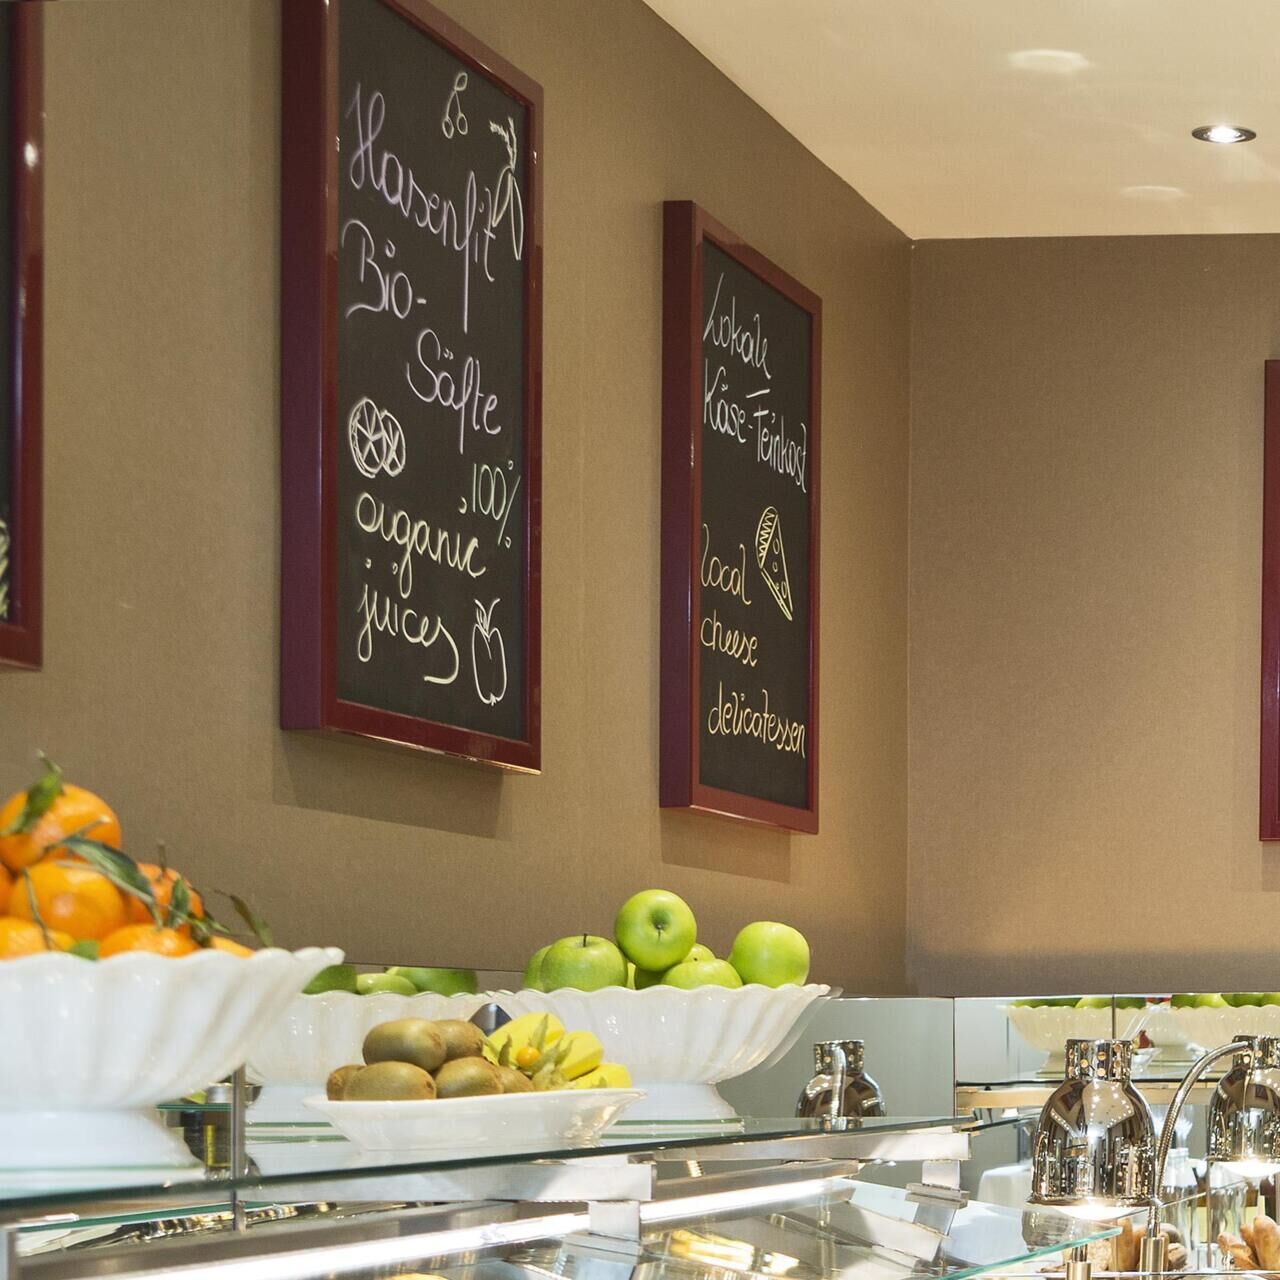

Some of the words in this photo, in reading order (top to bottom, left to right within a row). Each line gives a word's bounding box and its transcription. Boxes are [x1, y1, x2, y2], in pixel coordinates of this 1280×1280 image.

[406, 328, 500, 454] Säfte
[356, 492, 486, 598] organic
[701, 523, 751, 605] local
[357, 557, 459, 684] juices
[701, 609, 758, 667] cheese
[708, 680, 805, 758] delicatessen
